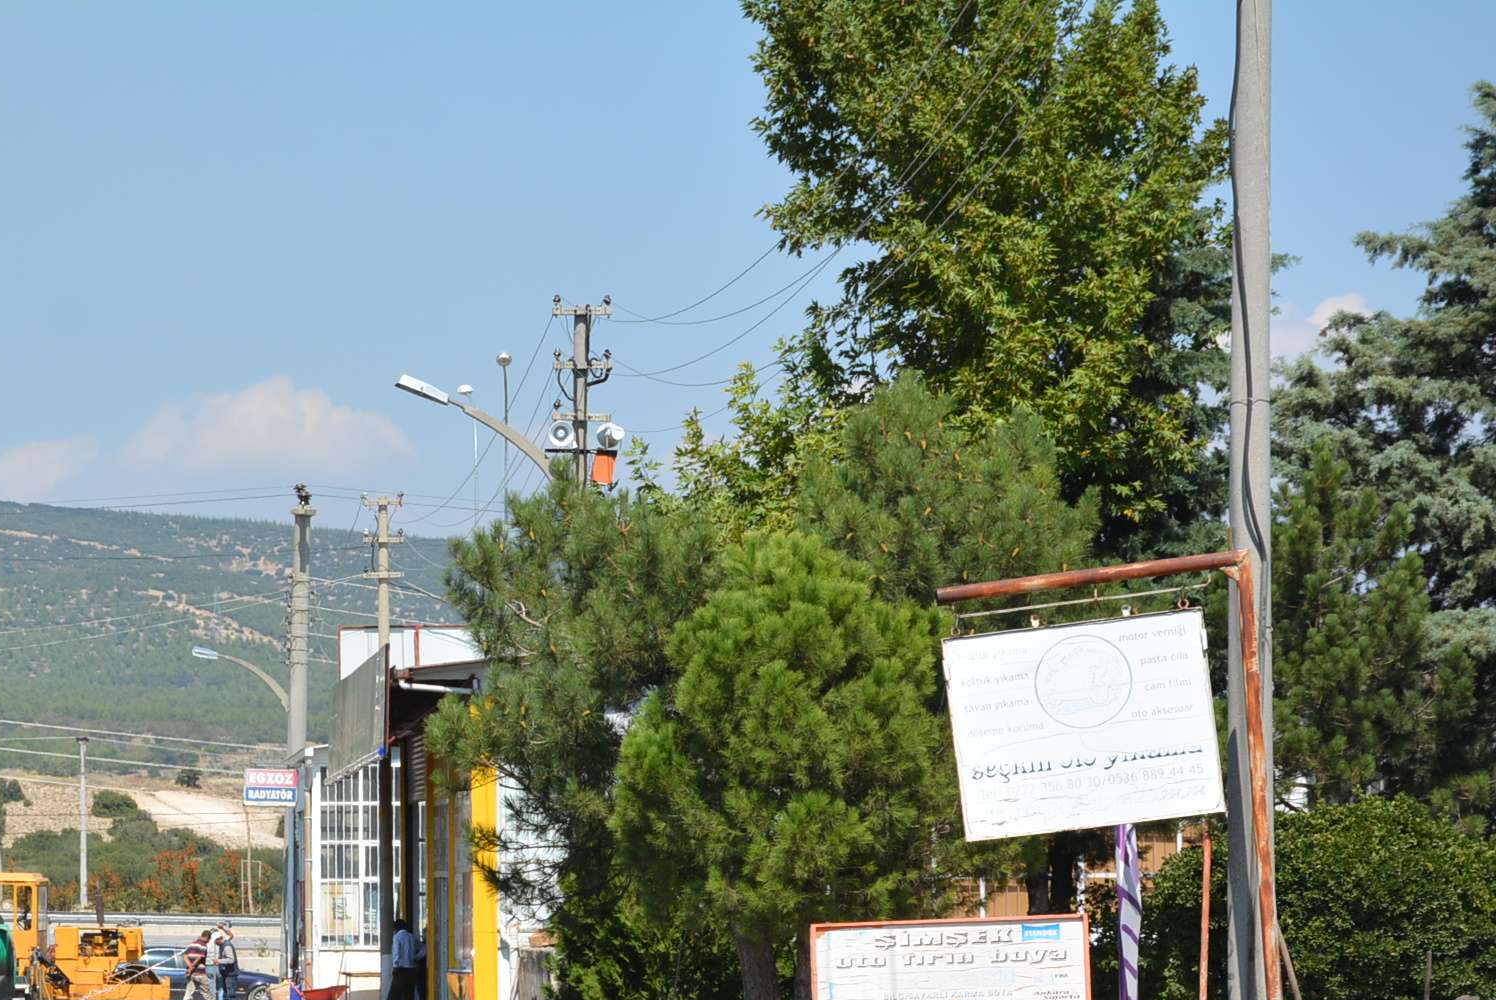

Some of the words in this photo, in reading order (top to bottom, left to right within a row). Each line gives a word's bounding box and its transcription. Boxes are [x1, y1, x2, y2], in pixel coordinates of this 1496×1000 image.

[1118, 631, 1148, 643] motor
[1139, 655, 1168, 668] pasta
[1144, 681, 1166, 692] cam
[1130, 709, 1149, 719] oto
[1150, 704, 1194, 718] aksesuar
[248, 772, 294, 785] EGZOZ
[1066, 776, 1083, 790] 80
[1142, 767, 1165, 781] 889
[1168, 765, 1185, 777] 44
[1188, 763, 1204, 775] 45
[248, 788, 294, 800] RADYATÖR
[874, 928, 1013, 951] ŞİMŞEK
